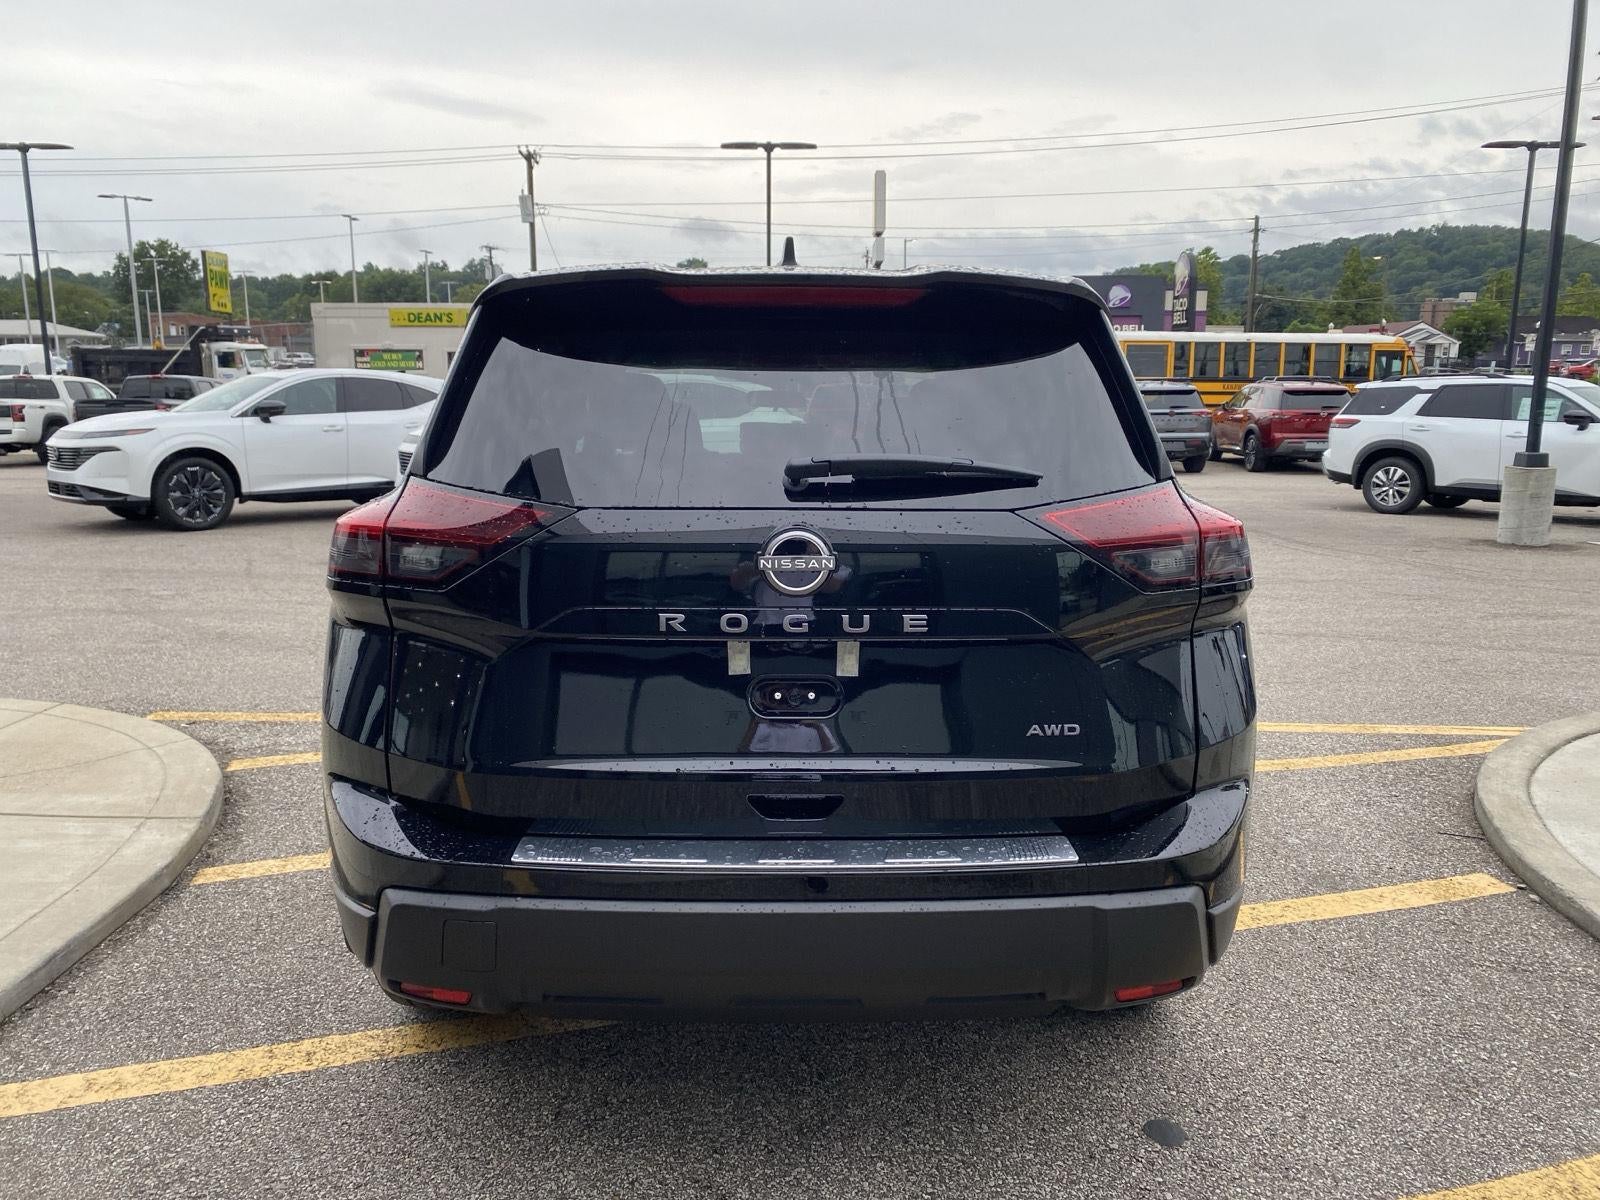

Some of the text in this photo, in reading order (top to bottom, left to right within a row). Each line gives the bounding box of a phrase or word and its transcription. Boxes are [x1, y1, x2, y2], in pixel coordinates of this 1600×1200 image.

[1173, 298, 1188, 312] TACO
[407, 312, 453, 323] DEAN'S
[1173, 311, 1187, 325] BELL
[760, 559, 834, 569] NISSAN
[658, 613, 929, 633] ROGUE
[1025, 723, 1081, 737] AWD
